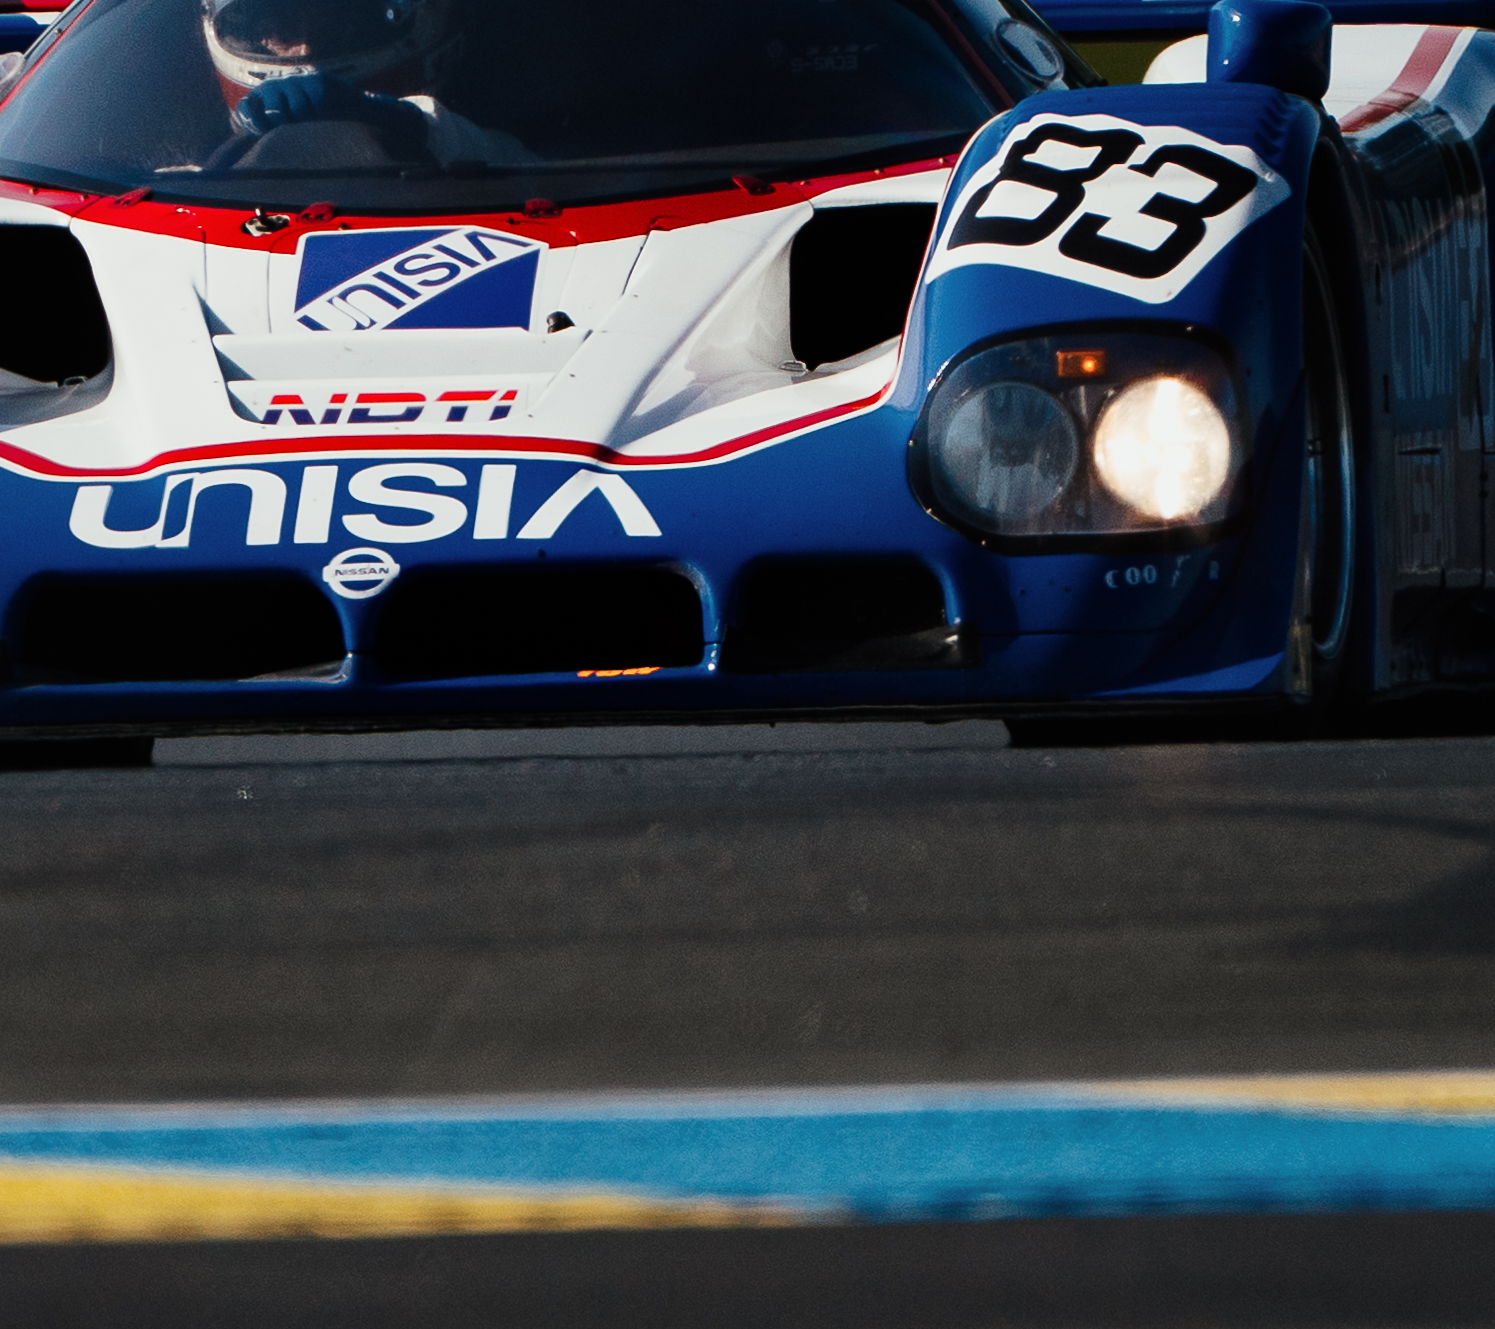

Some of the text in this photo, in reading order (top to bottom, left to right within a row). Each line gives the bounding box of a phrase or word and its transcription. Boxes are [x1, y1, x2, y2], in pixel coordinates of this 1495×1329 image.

[947, 123, 1258, 279] 83
[69, 463, 663, 548] UNISIA
[334, 567, 390, 577] NISSAN
